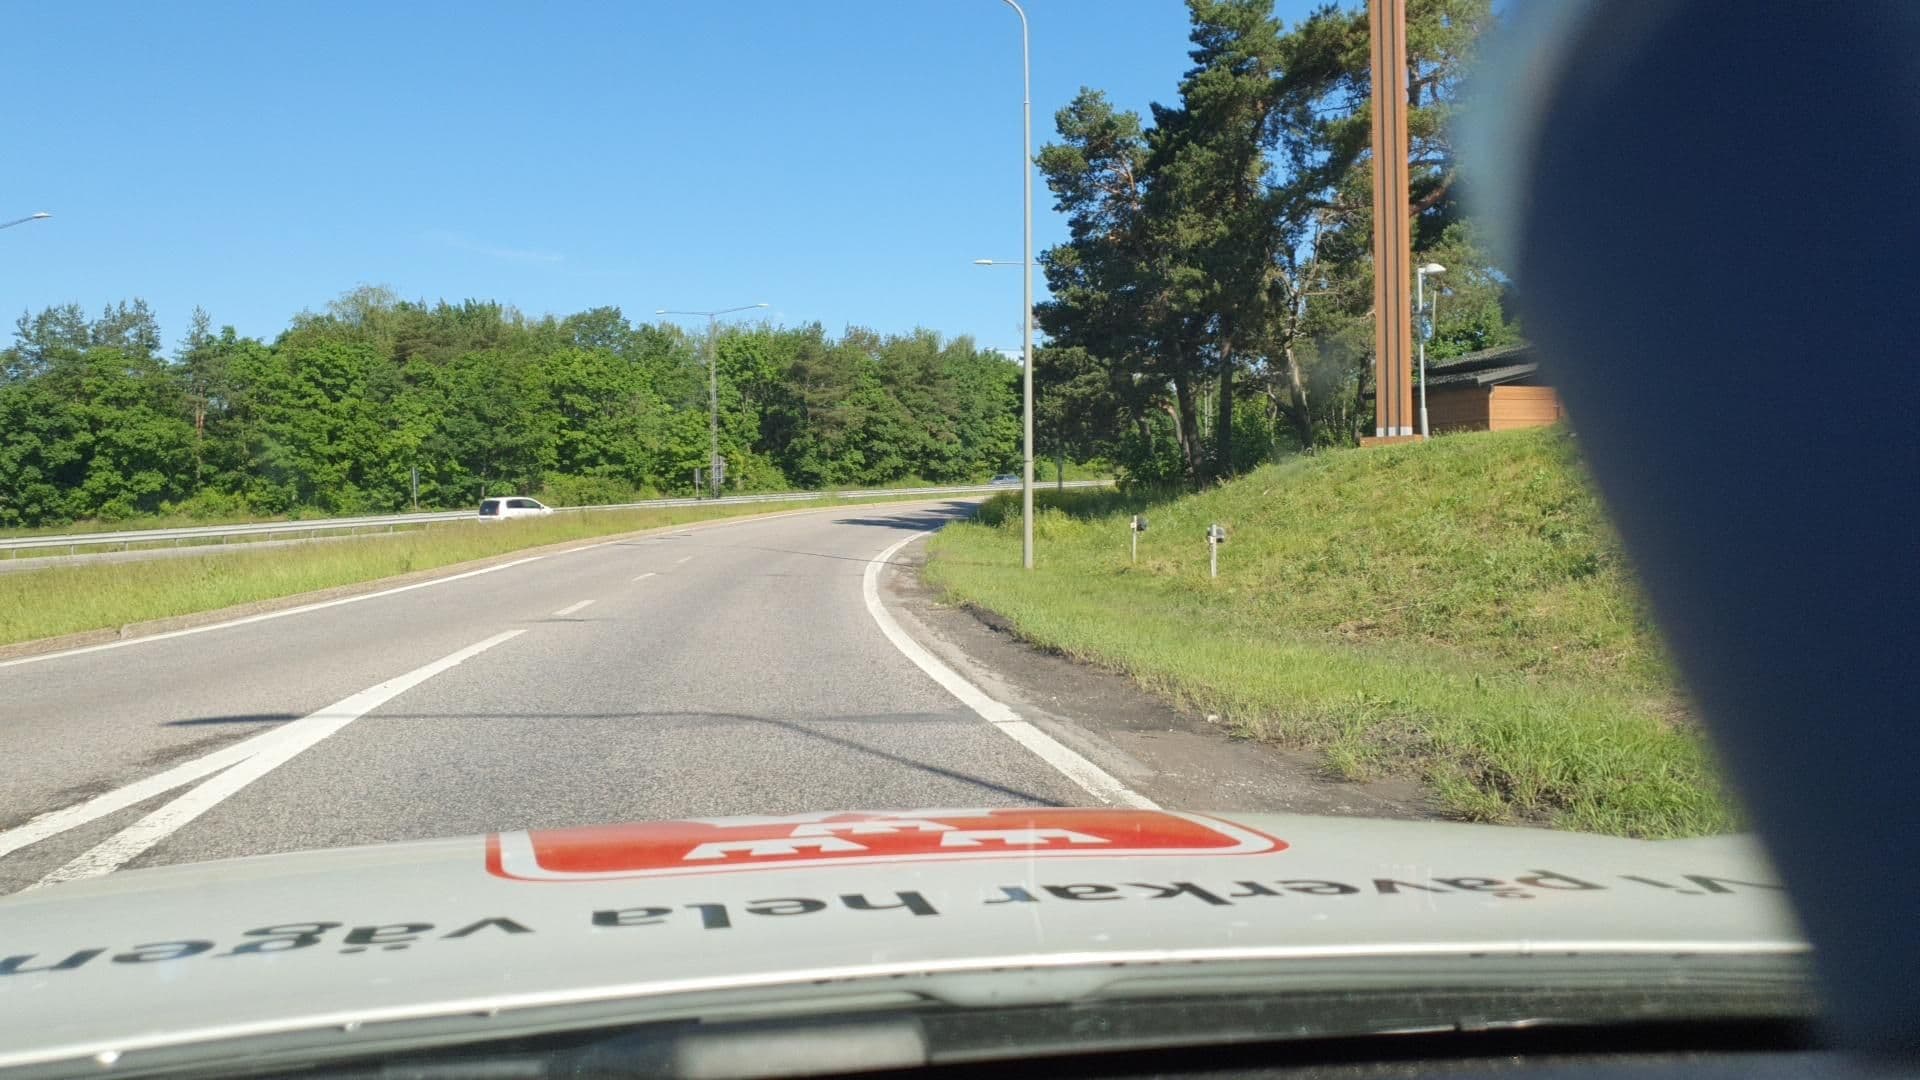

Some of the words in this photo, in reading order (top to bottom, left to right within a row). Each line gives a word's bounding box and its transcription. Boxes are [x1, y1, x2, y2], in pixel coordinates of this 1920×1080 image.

[983, 869, 1608, 906] påverkar
[1616, 874, 1789, 895] Vi
[591, 891, 940, 929] hela
[0, 917, 536, 975] vägen
